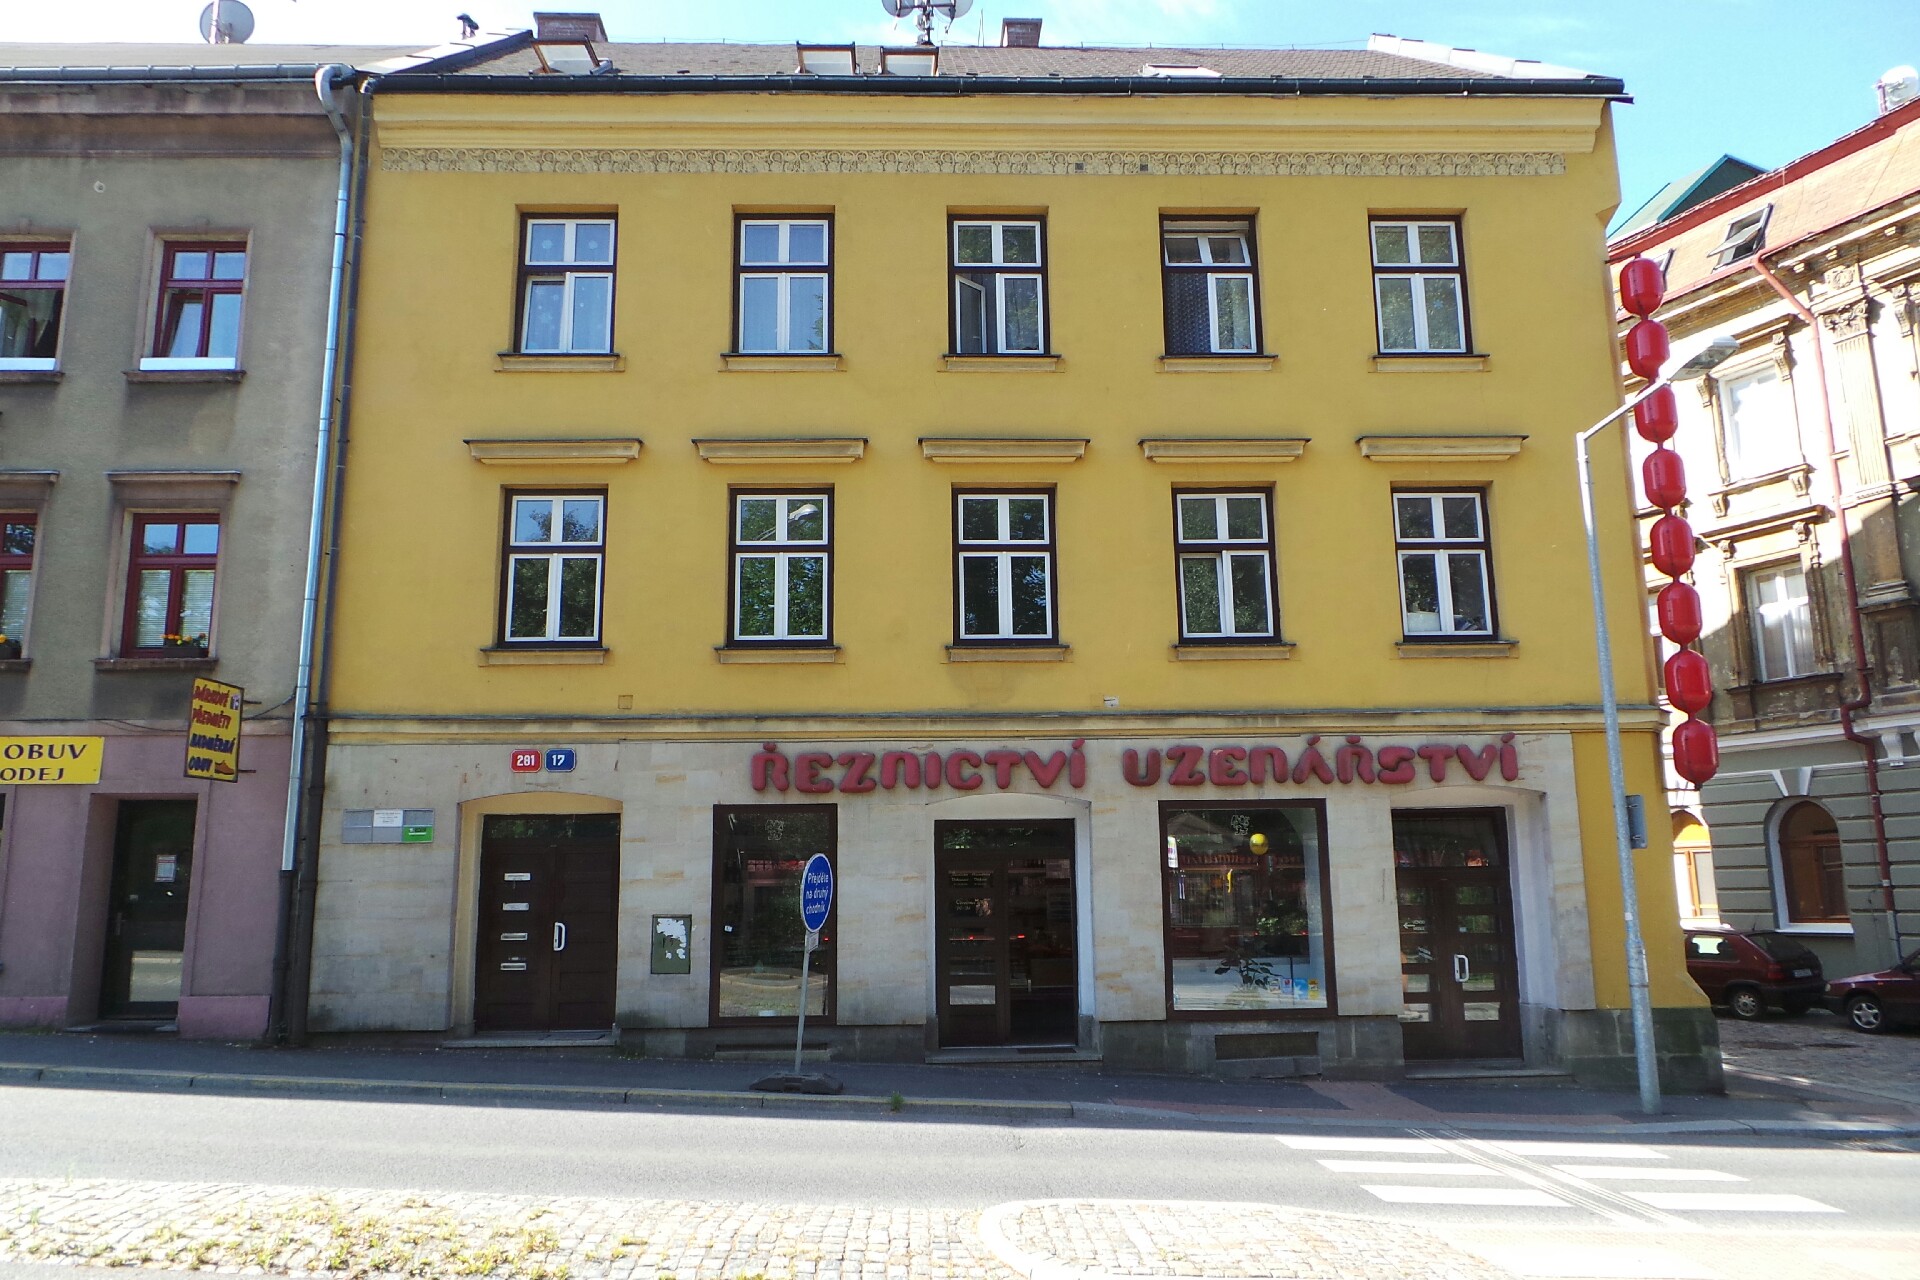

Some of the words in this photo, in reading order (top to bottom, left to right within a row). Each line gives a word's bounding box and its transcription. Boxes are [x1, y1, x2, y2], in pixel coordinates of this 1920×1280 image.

[4, 743, 88, 760] OBUV
[516, 754, 536, 767] 281
[552, 754, 566, 766] 17
[751, 738, 1086, 793] ŘEZNICTVÍ
[1122, 732, 1520, 787] UZENÁŘSTVÍ
[0, 767, 65, 781] ODEJ
[806, 890, 813, 899] na
[814, 886, 828, 900] druhý
[806, 901, 825, 914] chodník
